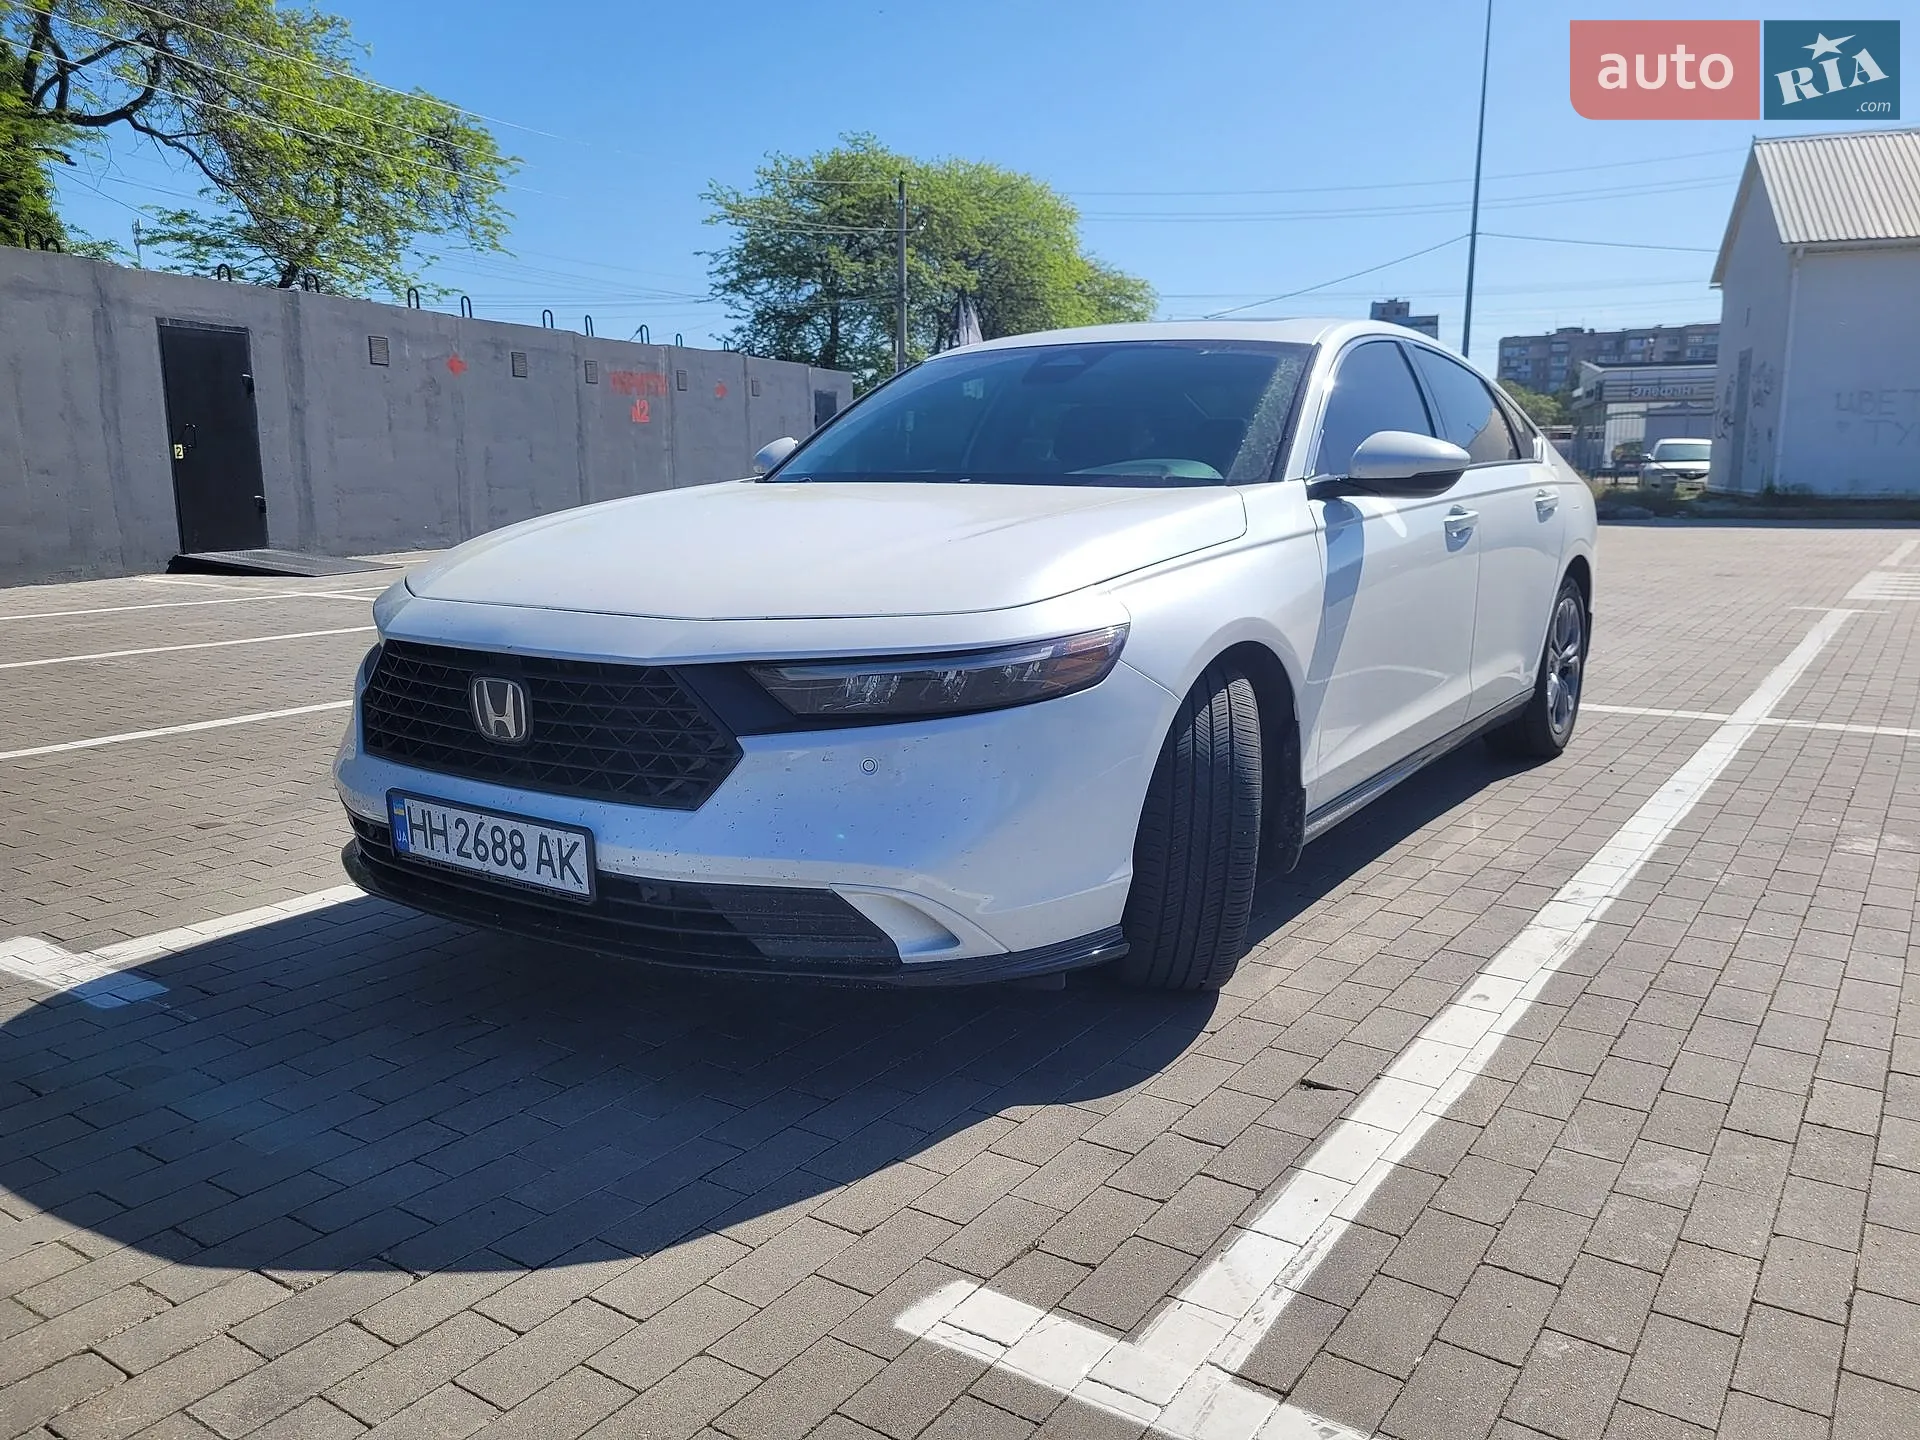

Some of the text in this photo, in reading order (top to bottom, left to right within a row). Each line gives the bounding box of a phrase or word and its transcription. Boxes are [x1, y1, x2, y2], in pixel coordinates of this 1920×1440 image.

[396, 829, 407, 842] UA
[407, 806, 583, 884] HH 2688 AK
